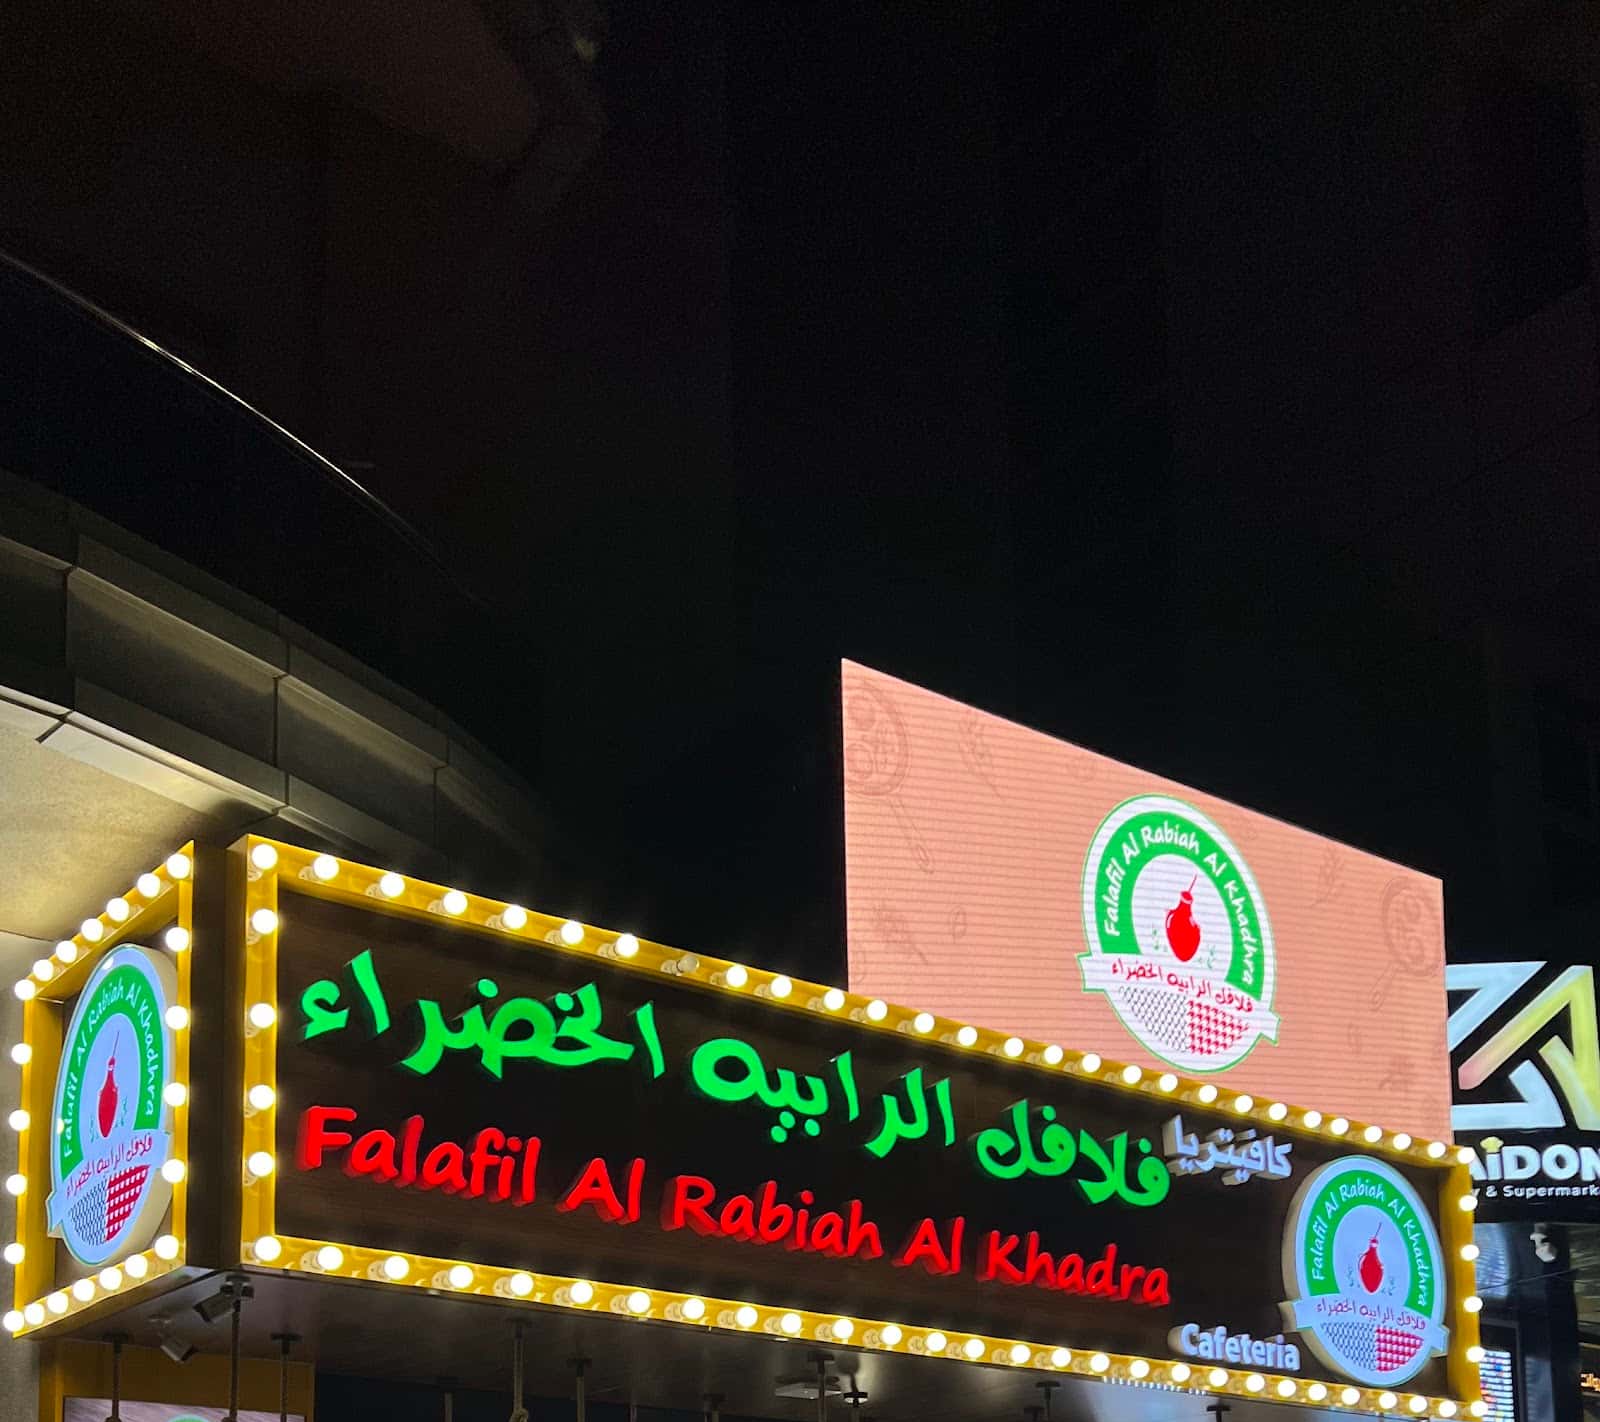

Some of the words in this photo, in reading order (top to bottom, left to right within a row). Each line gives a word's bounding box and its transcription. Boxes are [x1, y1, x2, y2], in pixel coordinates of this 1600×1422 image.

[1102, 857, 1126, 937] Falafil
[1122, 832, 1140, 865] Al
[1141, 820, 1200, 854] Rabiah
[1203, 852, 1228, 877] Al
[1223, 879, 1259, 984] Khadhra
[1112, 957, 1163, 981] الخضراء
[1215, 986, 1253, 1013] فلافل
[125, 982, 142, 1009] Al
[137, 998, 159, 1116] Khadhra
[301, 949, 665, 1079] الخضراء
[976, 1099, 1170, 1206] فلافل
[1164, 1114, 1293, 1185] كافيتريا
[1485, 1185, 1498, 1197] &
[1503, 1184, 1600, 1199] Supermark
[299, 1105, 542, 1205] Falafil
[562, 1157, 645, 1224] Al
[667, 1175, 883, 1259] Rabiah
[899, 1216, 966, 1275] Al
[984, 1230, 1170, 1305] Khadra
[1310, 1215, 1328, 1280] Falafil
[1324, 1191, 1340, 1219] Al
[1339, 1177, 1385, 1202] Rabiah
[1387, 1198, 1407, 1218] Al
[1403, 1218, 1430, 1307] Khadhra
[1176, 1322, 1301, 1371] Cafeteria
[1397, 1310, 1426, 1330] فلافل
